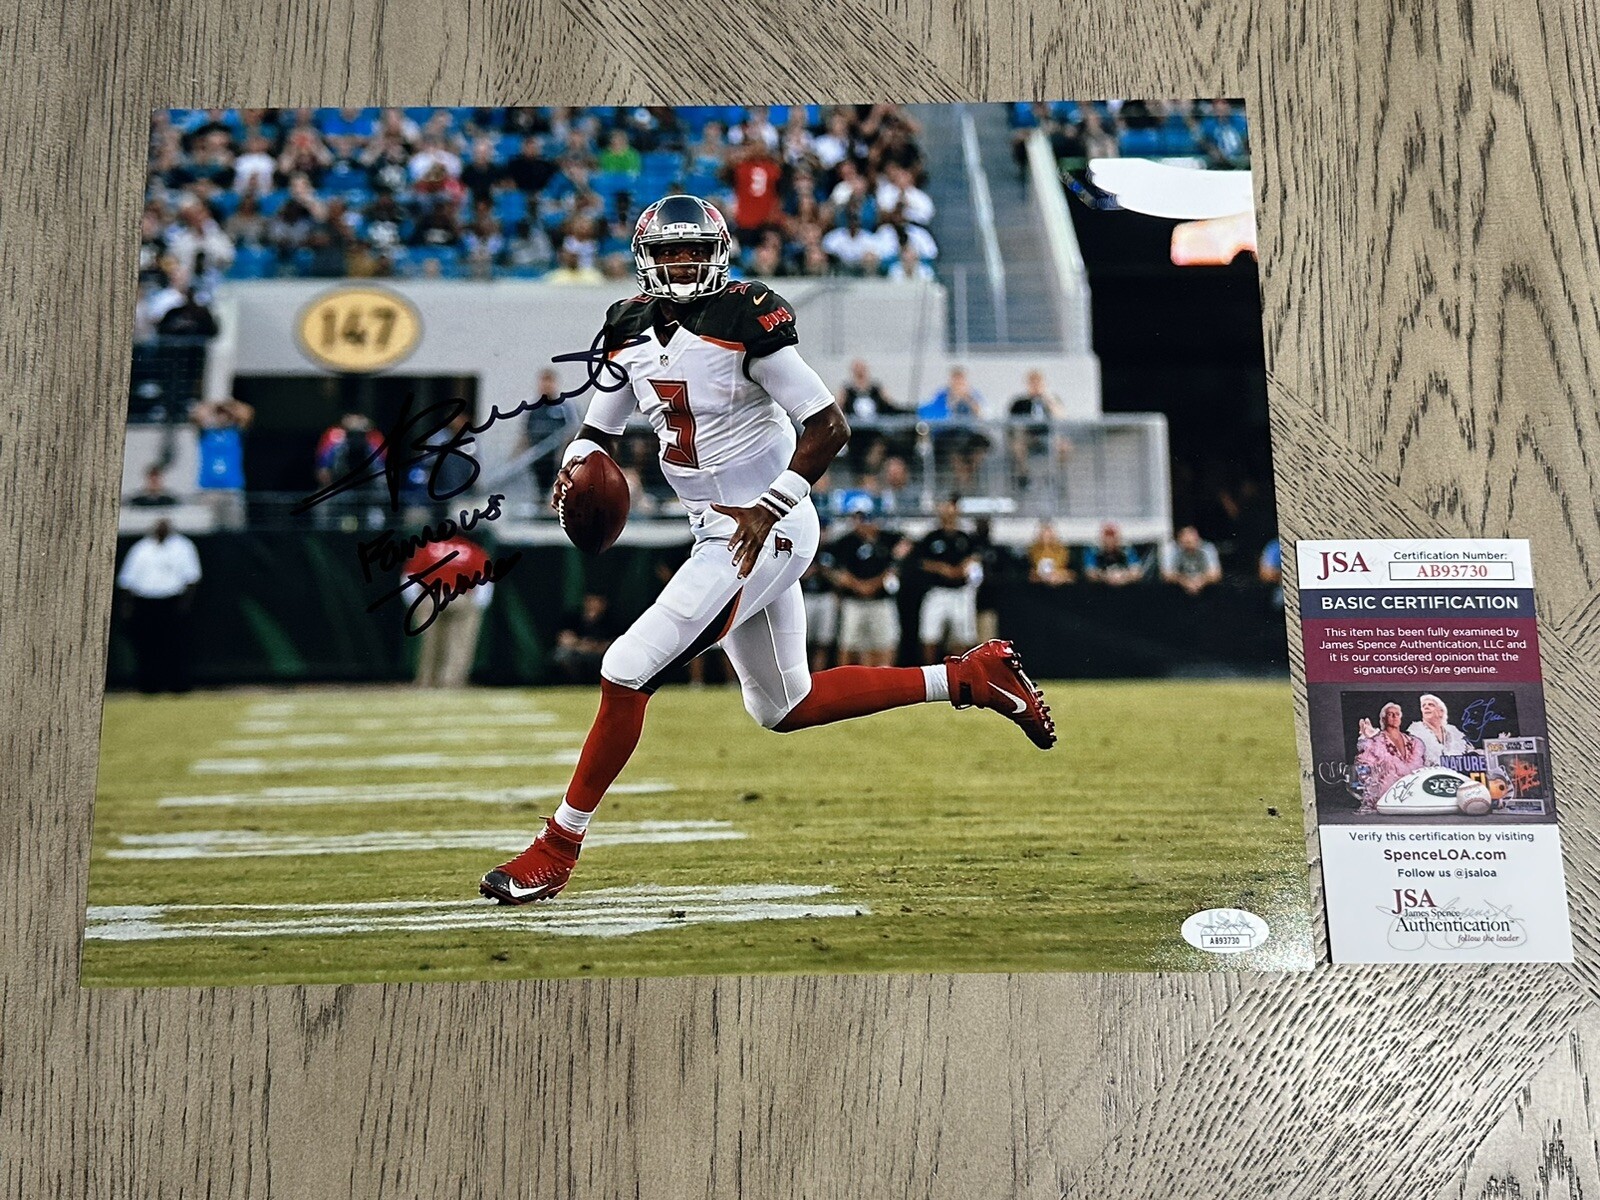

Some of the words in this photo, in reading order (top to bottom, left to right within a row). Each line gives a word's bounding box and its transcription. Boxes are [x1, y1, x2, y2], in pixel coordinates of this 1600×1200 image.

[321, 304, 396, 352] 147
[647, 378, 699, 469] 3
[358, 494, 505, 583] Famous
[1394, 551, 1460, 561] Certification
[1462, 551, 1508, 561] Number:
[1317, 551, 1371, 580] JSA
[1416, 565, 1488, 578] AB93730
[1321, 597, 1376, 610] BASIC
[1381, 596, 1519, 610] CERTIFICATION
[1324, 627, 1347, 637] This
[1349, 627, 1373, 637] item
[1376, 627, 1395, 637] has
[1397, 627, 1425, 637] been
[1427, 627, 1450, 638] fully
[1452, 627, 1504, 637] examined
[1506, 627, 1519, 638] by
[1319, 640, 1354, 650] James
[1356, 640, 1397, 650] Spence
[1399, 640, 1481, 650] Authentication,
[1483, 640, 1504, 649] LLC
[1506, 640, 1527, 649] and
[1329, 653, 1338, 662] it
[1340, 653, 1349, 662] is
[1351, 653, 1370, 662] our
[1372, 652, 1432, 662] considered
[1434, 652, 1475, 662] opinion
[1477, 652, 1499, 661] that
[1501, 652, 1519, 661] the
[1353, 665, 1418, 675] signature(s)
[1421, 664, 1450, 674] is/are
[1453, 665, 1498, 675] genuine.
[1440, 755, 1487, 772] NATURE
[1349, 832, 1382, 842] Verify
[1386, 832, 1406, 841] this
[1409, 832, 1475, 841] certification
[1478, 832, 1491, 842] by
[1495, 832, 1535, 842] visiting
[1384, 849, 1507, 862] SpenceLOA.com
[1397, 868, 1435, 877] Follow
[1439, 869, 1451, 877] us
[1453, 868, 1497, 879] @jsaloa
[1391, 888, 1437, 915] JSA
[1206, 911, 1251, 926] JSA
[1404, 908, 1429, 917] James
[1431, 908, 1460, 918] Spence
[1395, 917, 1511, 932] Authentication
[1209, 937, 1240, 945] AB93730
[1458, 934, 1481, 943] follow
